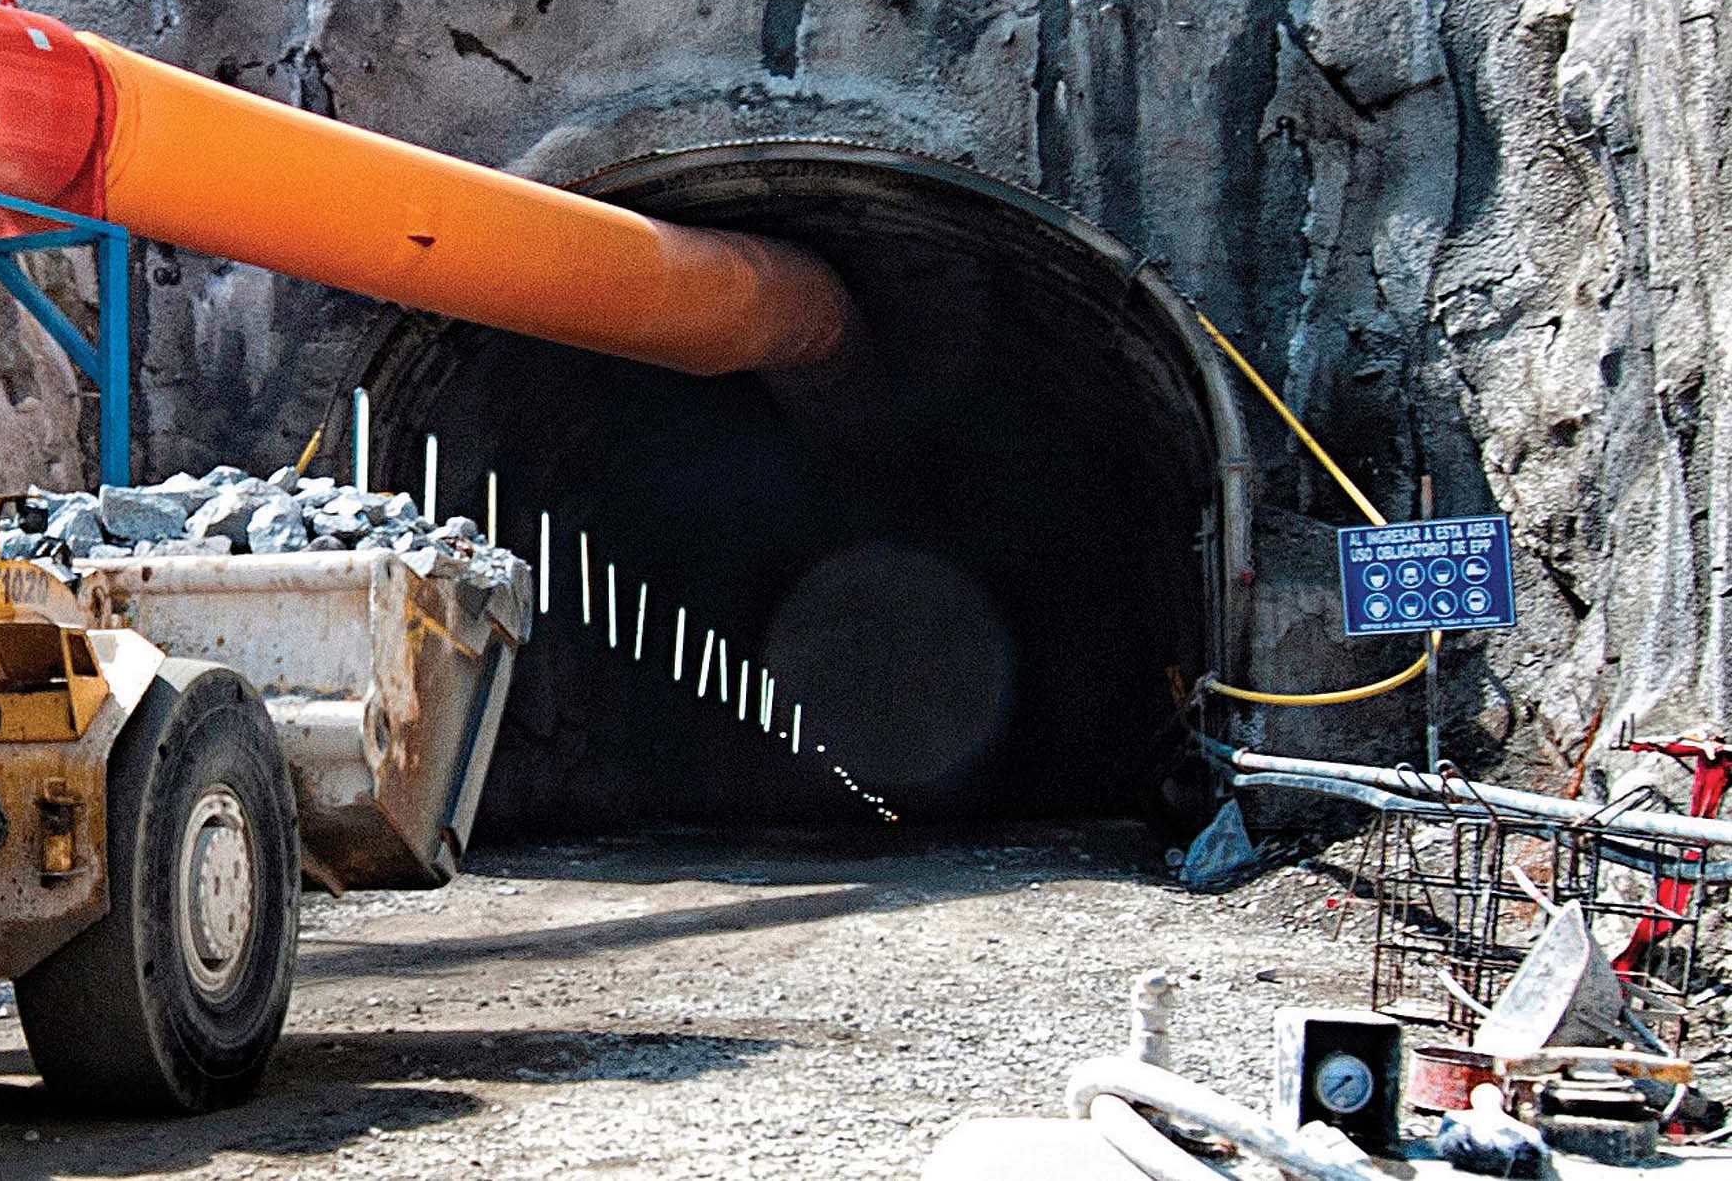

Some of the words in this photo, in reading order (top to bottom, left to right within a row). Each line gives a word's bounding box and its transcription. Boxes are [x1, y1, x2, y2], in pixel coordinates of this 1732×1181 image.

[1349, 532, 1363, 546] AL
[1366, 527, 1421, 545] INGRESAR
[1424, 526, 1432, 541] A
[1435, 524, 1463, 540] ESTA
[1467, 522, 1496, 538] AREA
[1350, 546, 1373, 562] USO
[1376, 541, 1448, 560] OBLIGATORIO
[1451, 540, 1467, 555] DE
